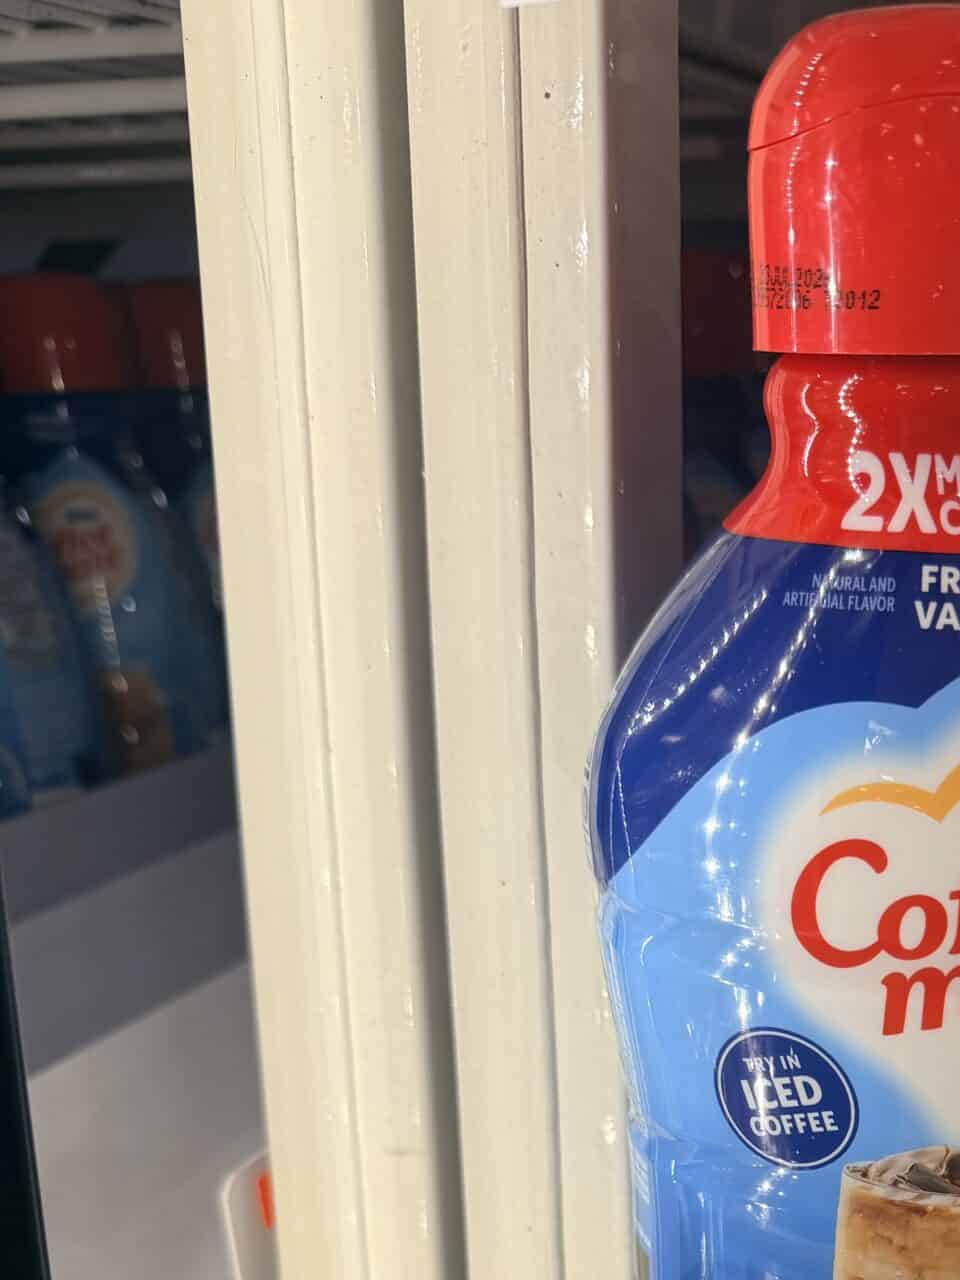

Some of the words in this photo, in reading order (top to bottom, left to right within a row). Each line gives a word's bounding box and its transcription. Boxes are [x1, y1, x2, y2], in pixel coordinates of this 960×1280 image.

[841, 450, 937, 534] 2X
[868, 575, 897, 594] AND
[848, 595, 896, 613] FLAVOR
[742, 1056, 775, 1075] TRY
[780, 1054, 802, 1071] IN
[740, 1075, 823, 1110] ICED
[750, 1111, 839, 1137] COFFEE
